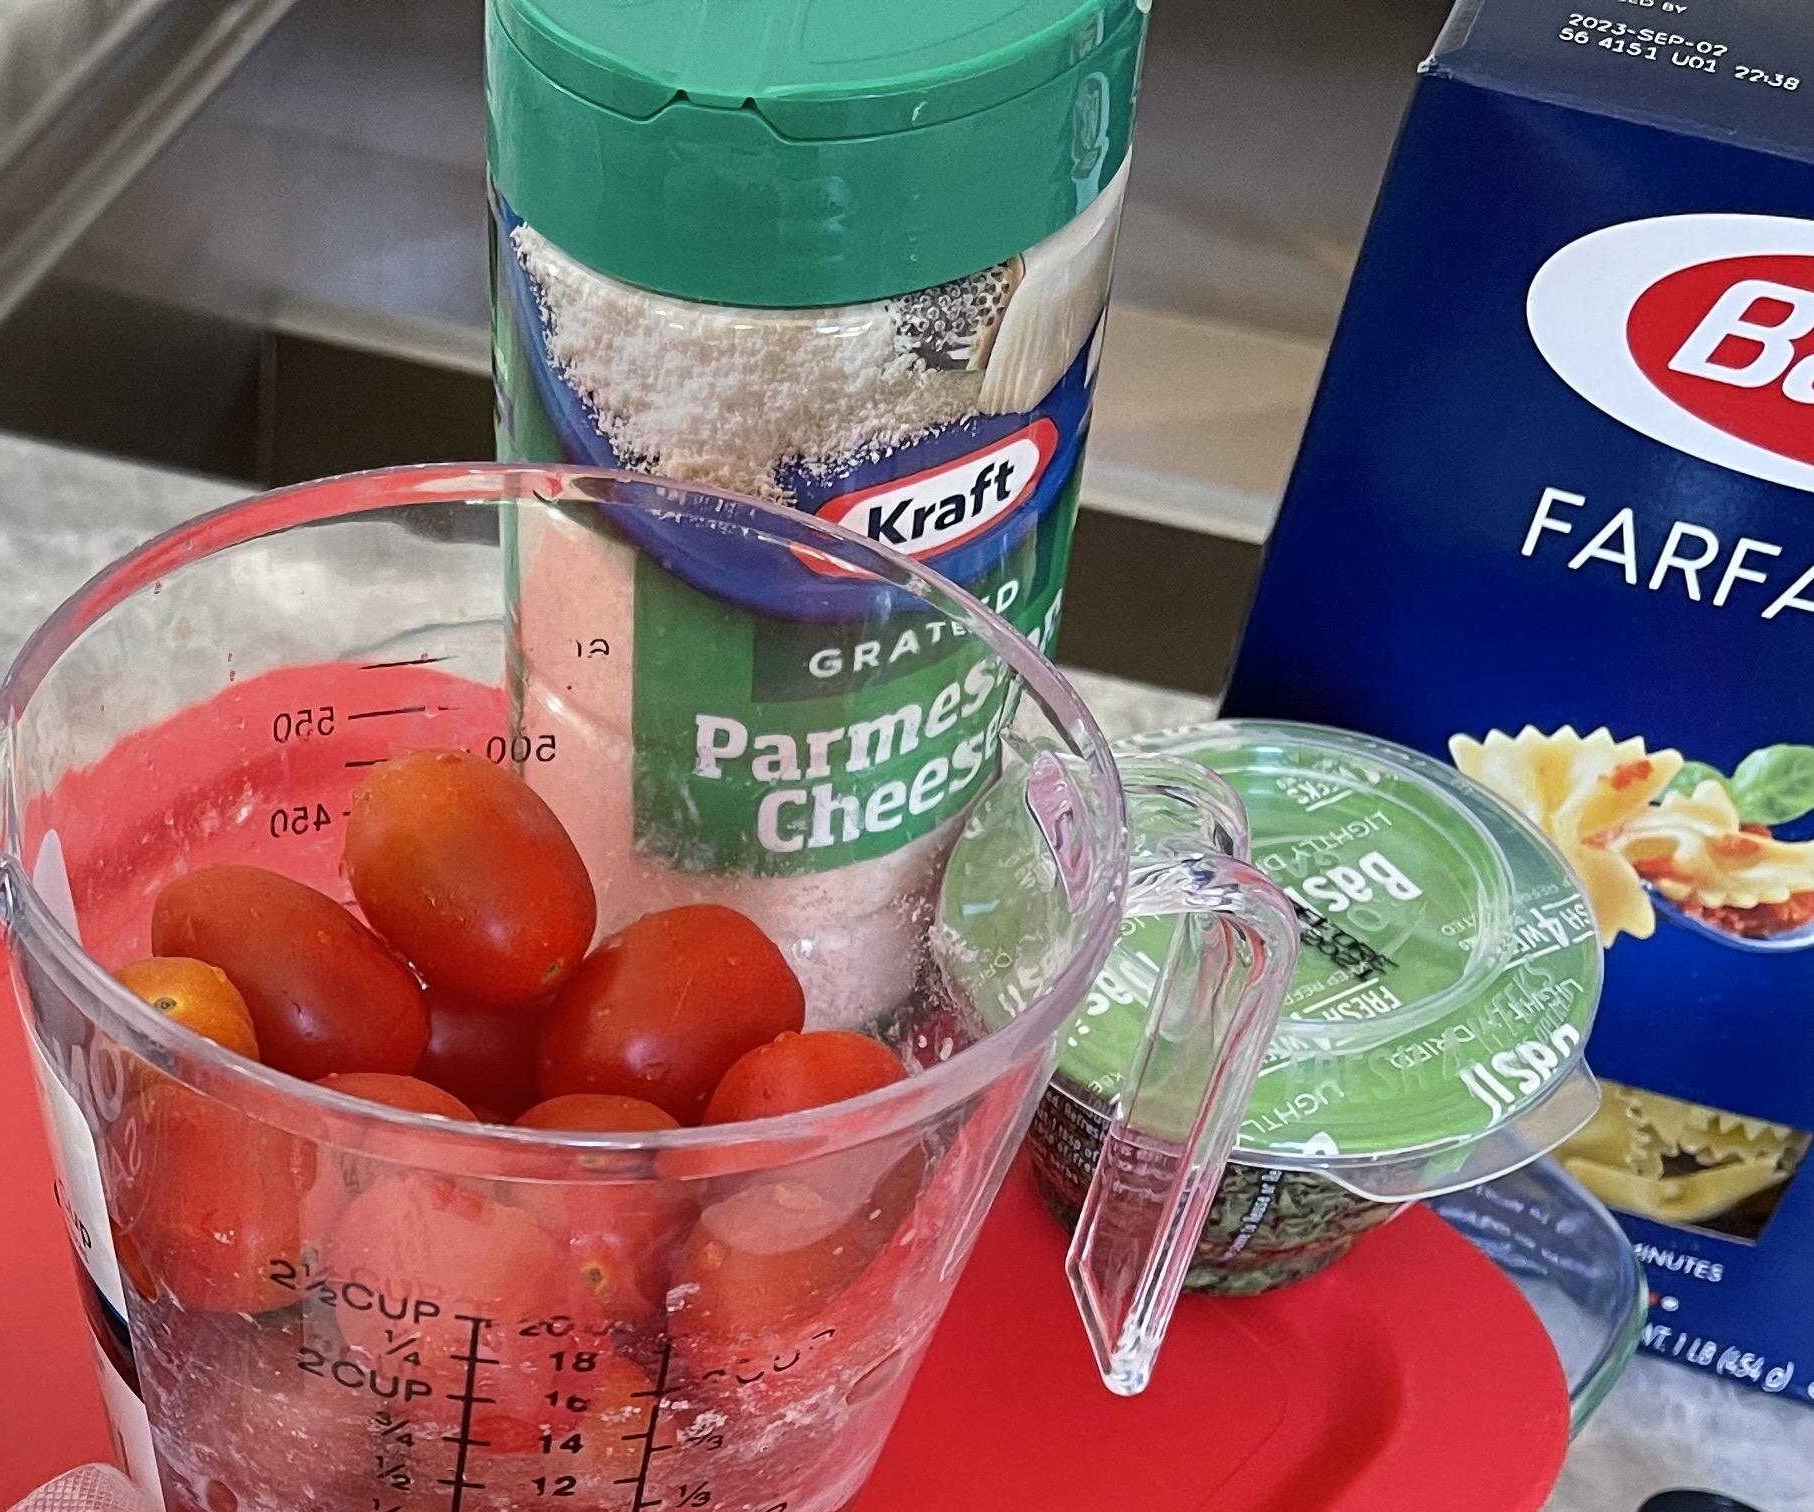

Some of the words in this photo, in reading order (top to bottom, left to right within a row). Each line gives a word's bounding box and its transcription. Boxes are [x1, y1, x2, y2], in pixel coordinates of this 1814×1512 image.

[1559, 27, 1589, 45] 56
[1598, 37, 1657, 61] 4151
[1734, 65, 1800, 91] 22:38
[867, 459, 1015, 545] Kraft
[550, 1352, 597, 1372] 18
[539, 1435, 584, 1454] 14
[531, 1476, 577, 1496] 12
